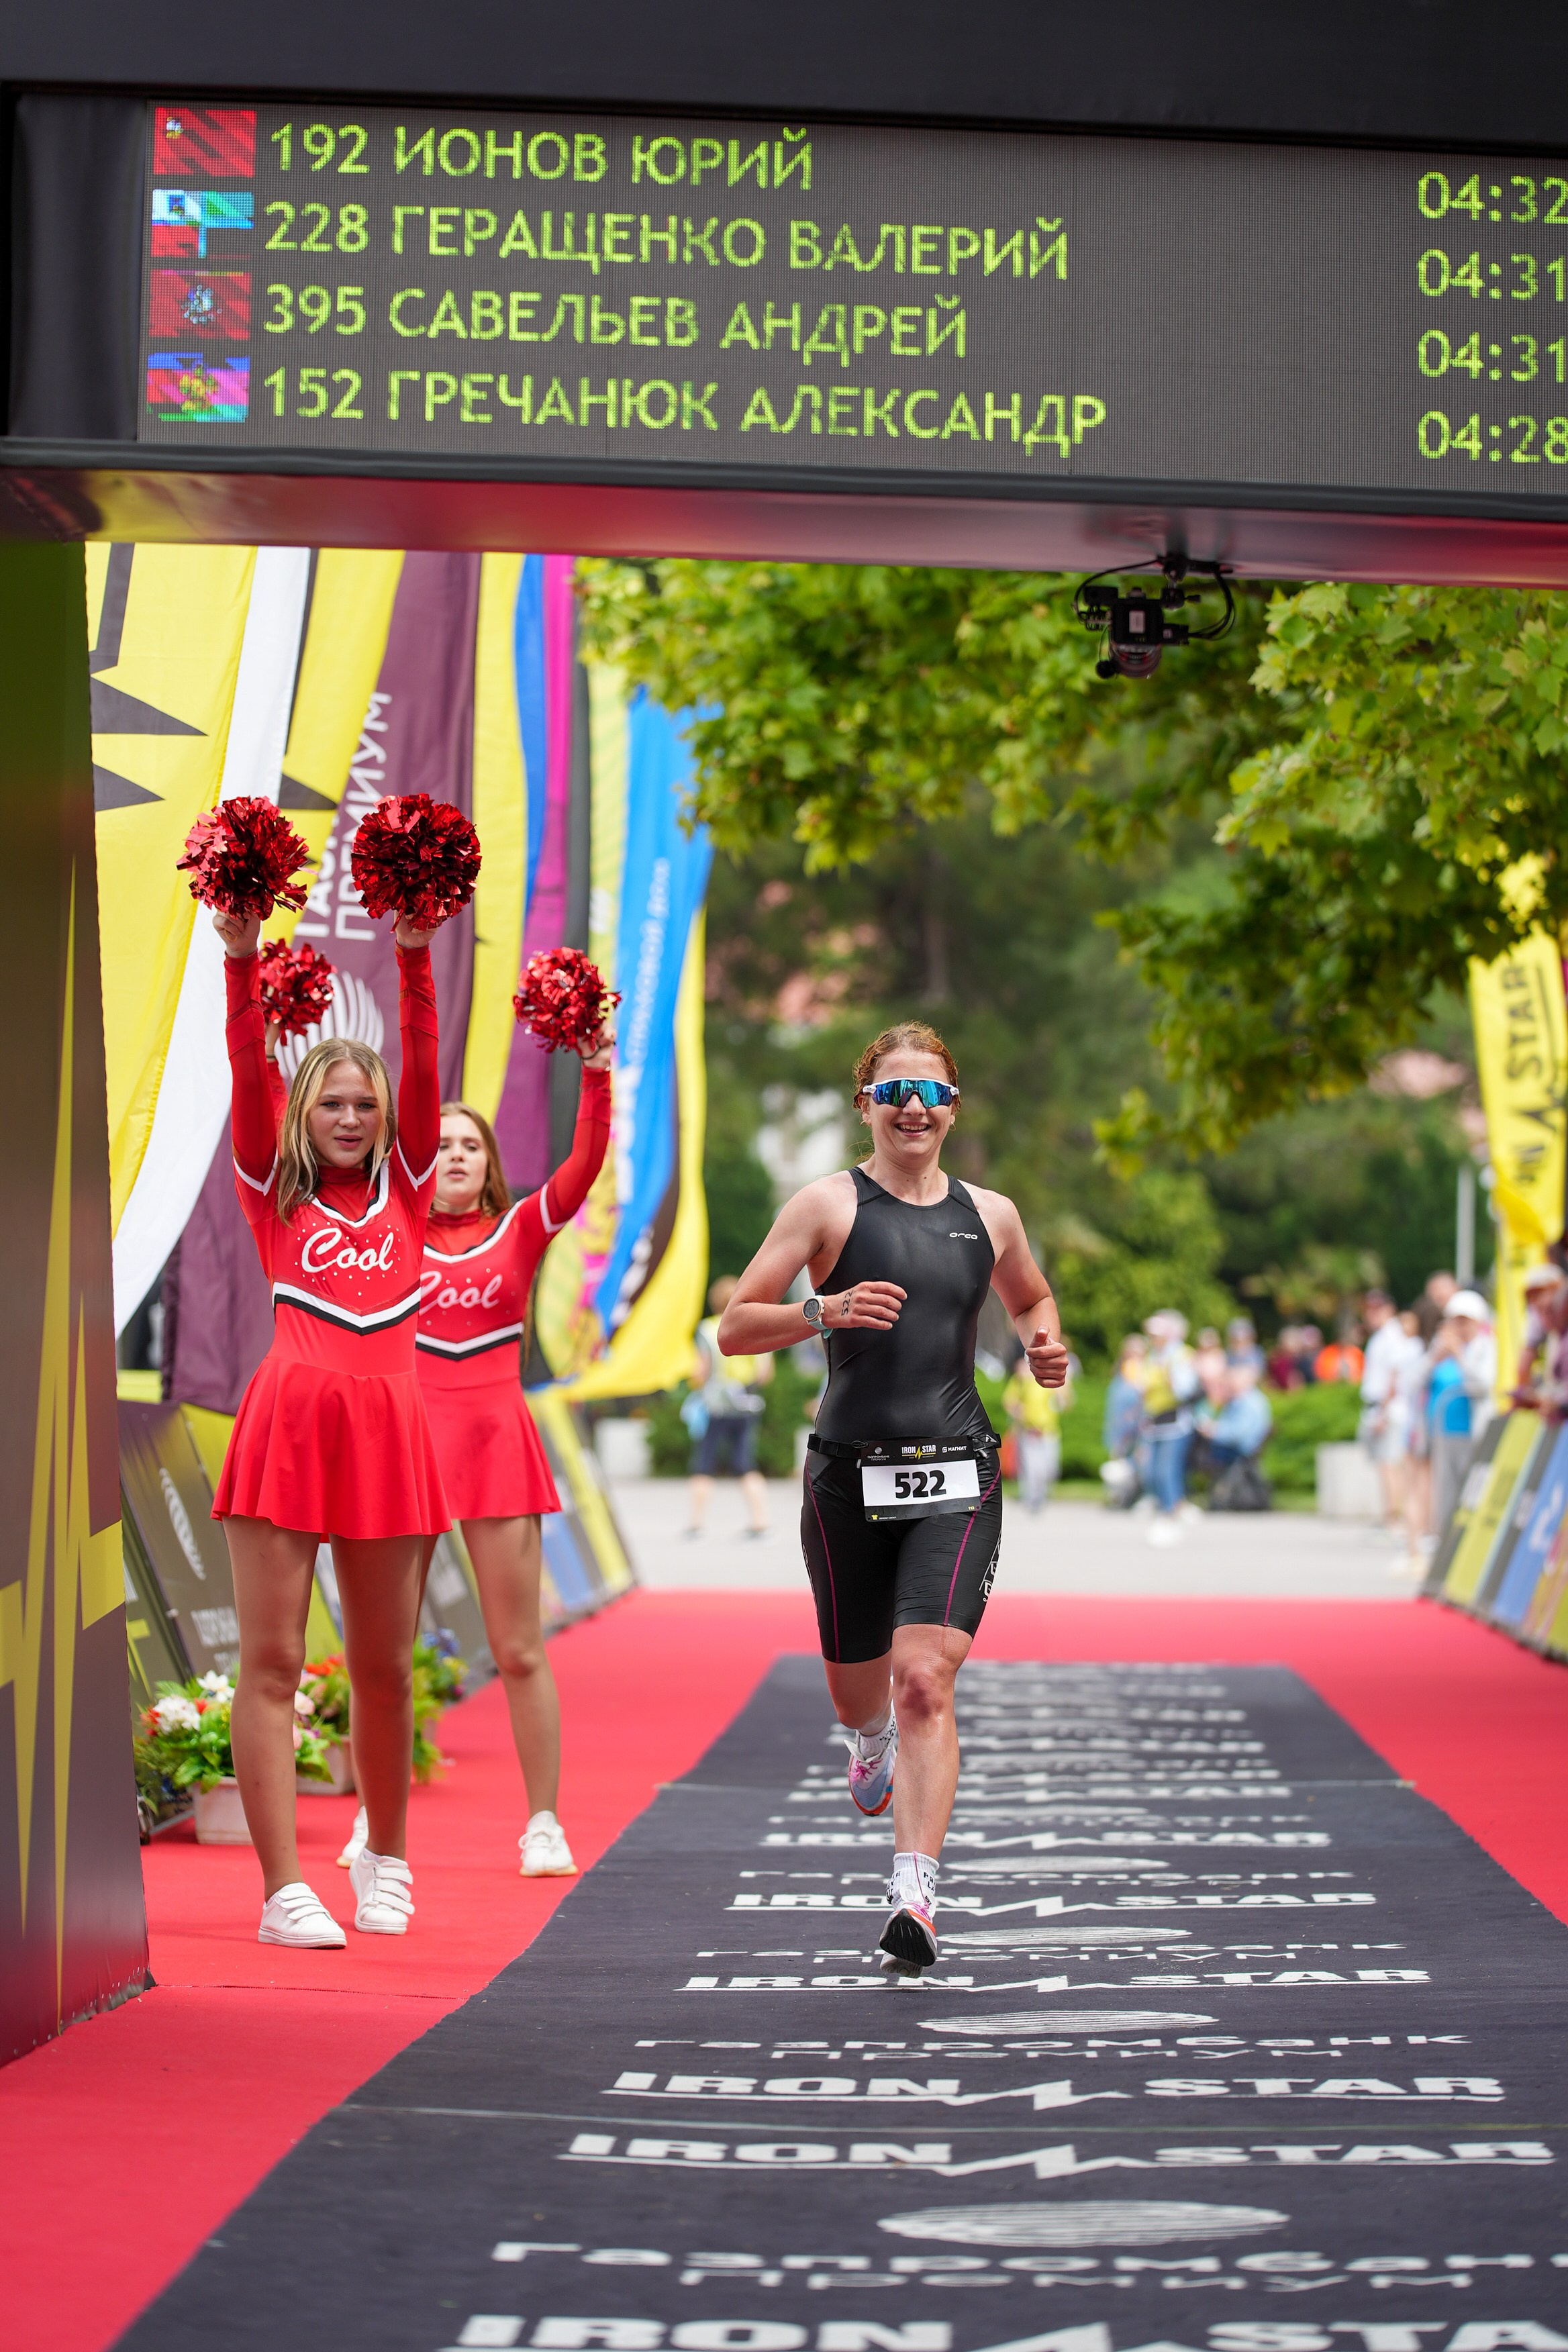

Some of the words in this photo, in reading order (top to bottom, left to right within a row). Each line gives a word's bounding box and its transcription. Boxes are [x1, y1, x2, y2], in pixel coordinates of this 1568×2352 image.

[271, 124, 369, 174] 192
[394, 126, 608, 182] ИОНОВ
[632, 127, 812, 191] ЮРИЙ
[1417, 172, 1568, 224] 04:32
[264, 201, 369, 253] 228
[392, 205, 767, 275] ГЕРАЩЕНКО
[790, 217, 1067, 280] ВАЛЕРИЙ
[1417, 249, 1565, 301] 04:31
[264, 284, 366, 335] 395
[389, 288, 699, 347] САВЕЛЬЕВ
[720, 293, 966, 367] АНДРЕЙ
[1417, 330, 1565, 383] 04:31
[264, 367, 363, 419] 152
[387, 370, 718, 430] ГРЕЧАНЮК
[740, 385, 1106, 458] АЛЕКСАНДР
[1417, 411, 1568, 464] 04:28
[301, 1227, 394, 1273] Cool
[841, 1290, 853, 1316] 522
[901, 1446, 916, 1454] IRON
[922, 1444, 936, 1453] STAR
[895, 1470, 946, 1499] 522
[733, 1894, 982, 1907] IRON
[1116, 1893, 1377, 1906] STAR
[685, 1976, 973, 1988] IRON
[1130, 1969, 1431, 1985] STAR
[613, 2071, 960, 2095] IRON
[1144, 2077, 1504, 2096] STAR
[569, 2133, 952, 2163] IRON
[1155, 2141, 1554, 2163] STAR
[457, 2314, 953, 2351] IRON
